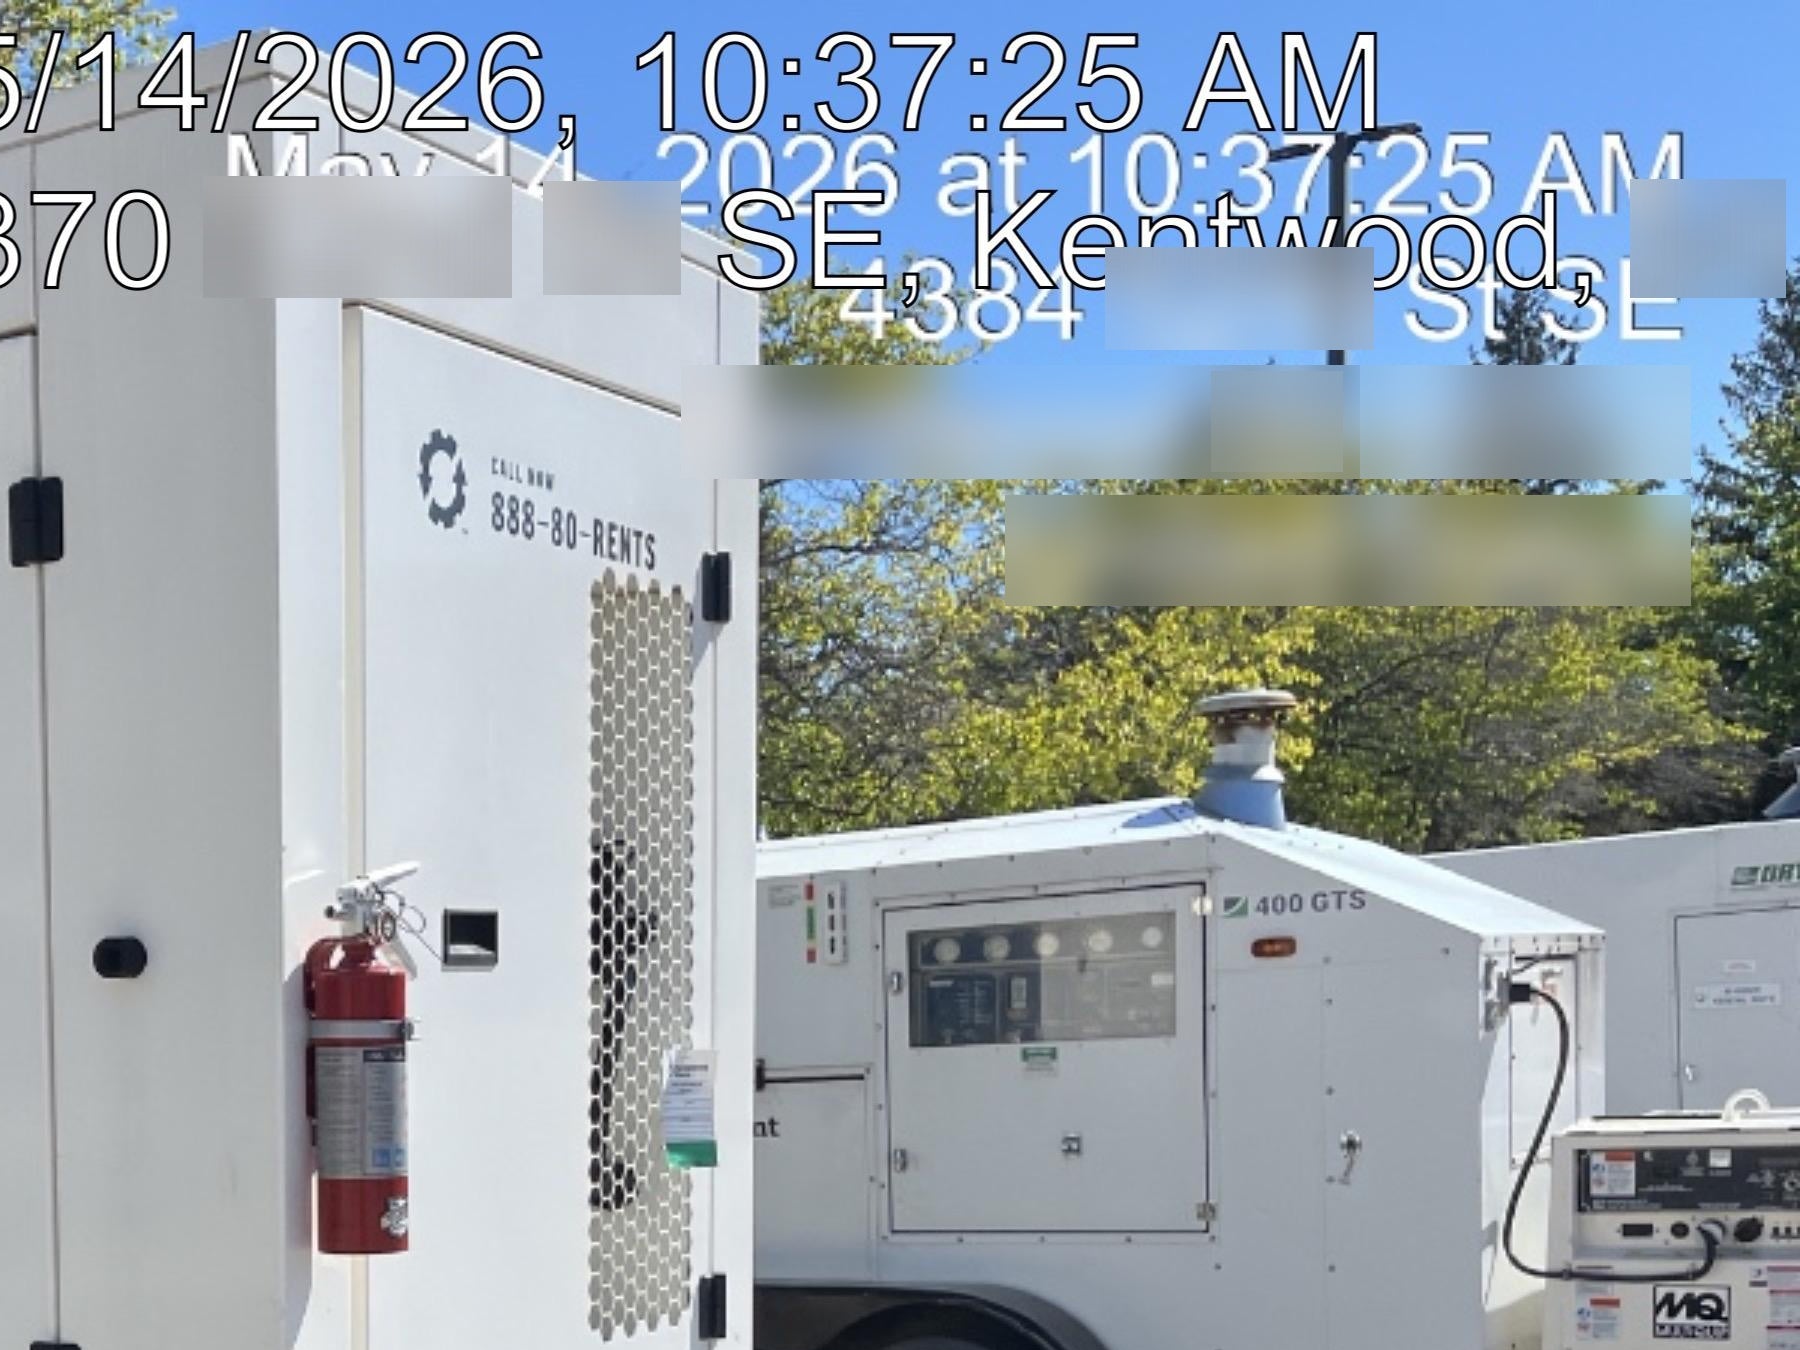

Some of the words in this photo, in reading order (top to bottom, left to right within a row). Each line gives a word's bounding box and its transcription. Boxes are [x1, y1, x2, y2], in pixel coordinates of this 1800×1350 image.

[491, 491, 656, 571] 888-80-RENTS
[1255, 893, 1303, 916] 400
[1310, 889, 1367, 913] GTS
